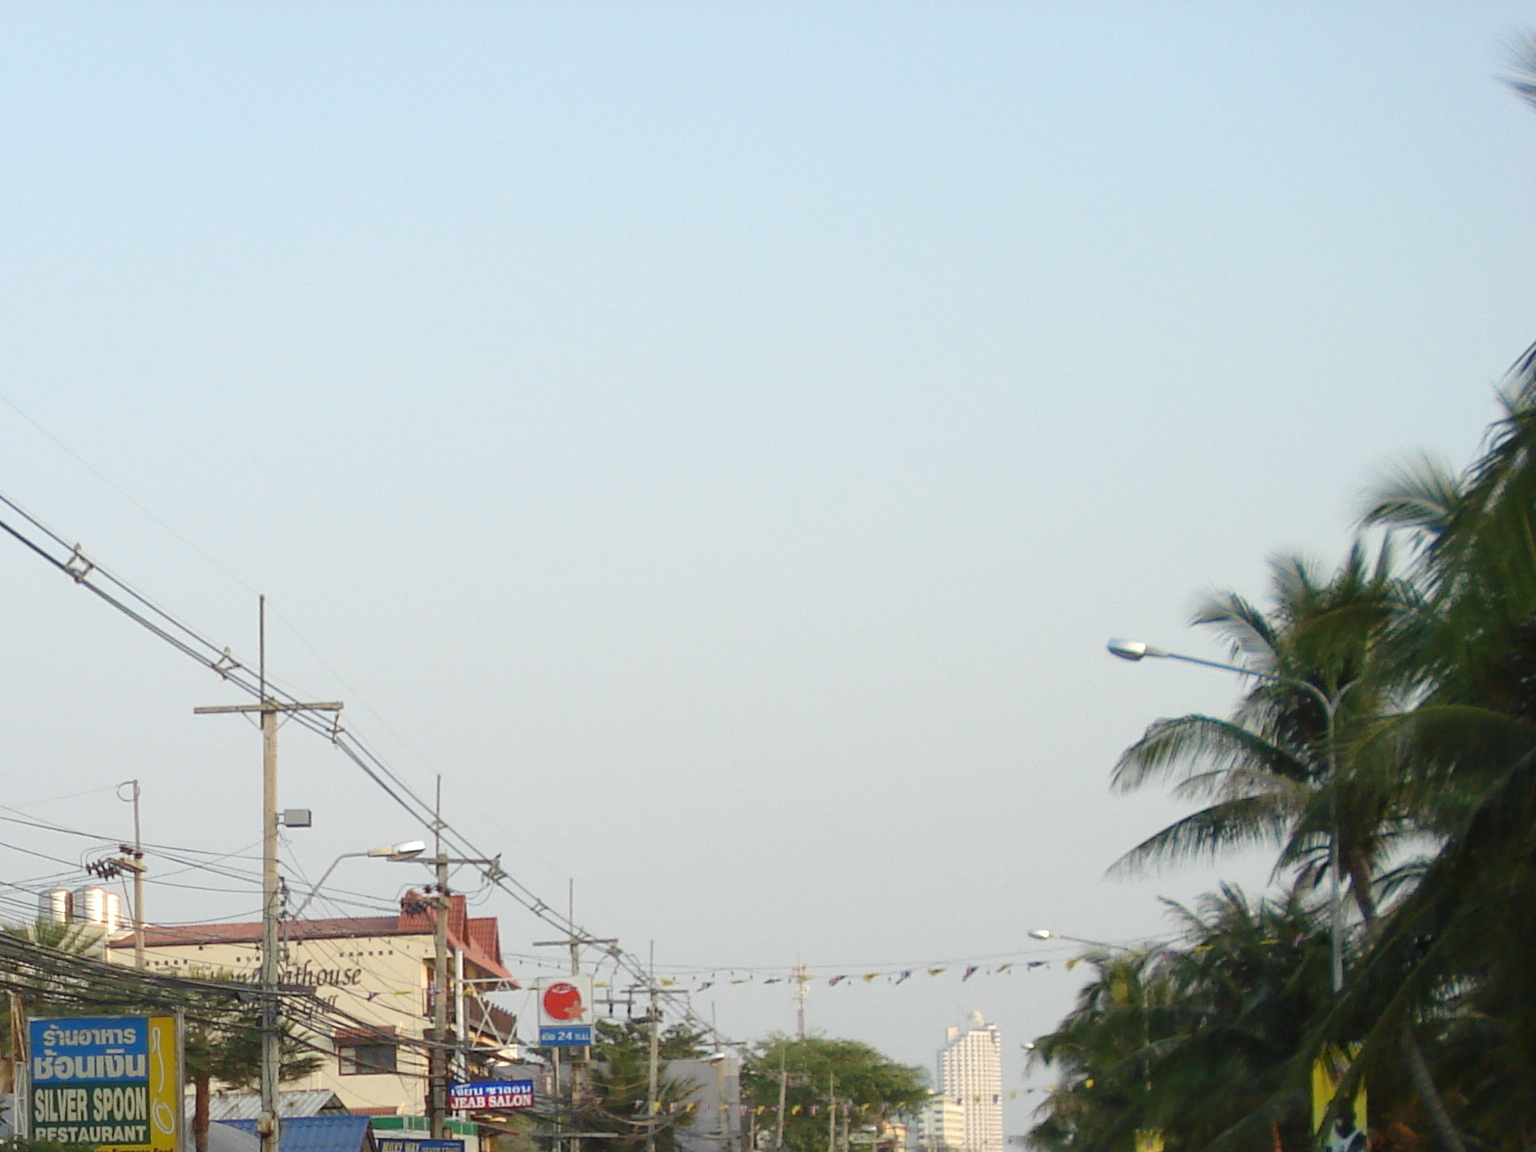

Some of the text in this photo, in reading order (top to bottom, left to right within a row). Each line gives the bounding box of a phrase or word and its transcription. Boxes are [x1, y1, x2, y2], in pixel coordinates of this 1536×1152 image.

[42, 1024, 137, 1047] ร้านอาหาร
[557, 1031, 573, 1041] 24
[33, 1049, 146, 1080] ช้อนเงิน
[34, 1087, 147, 1123] SILVER SPOON
[450, 1095, 532, 1110] JEAB SALON
[35, 1125, 147, 1143] RESTAURANT
